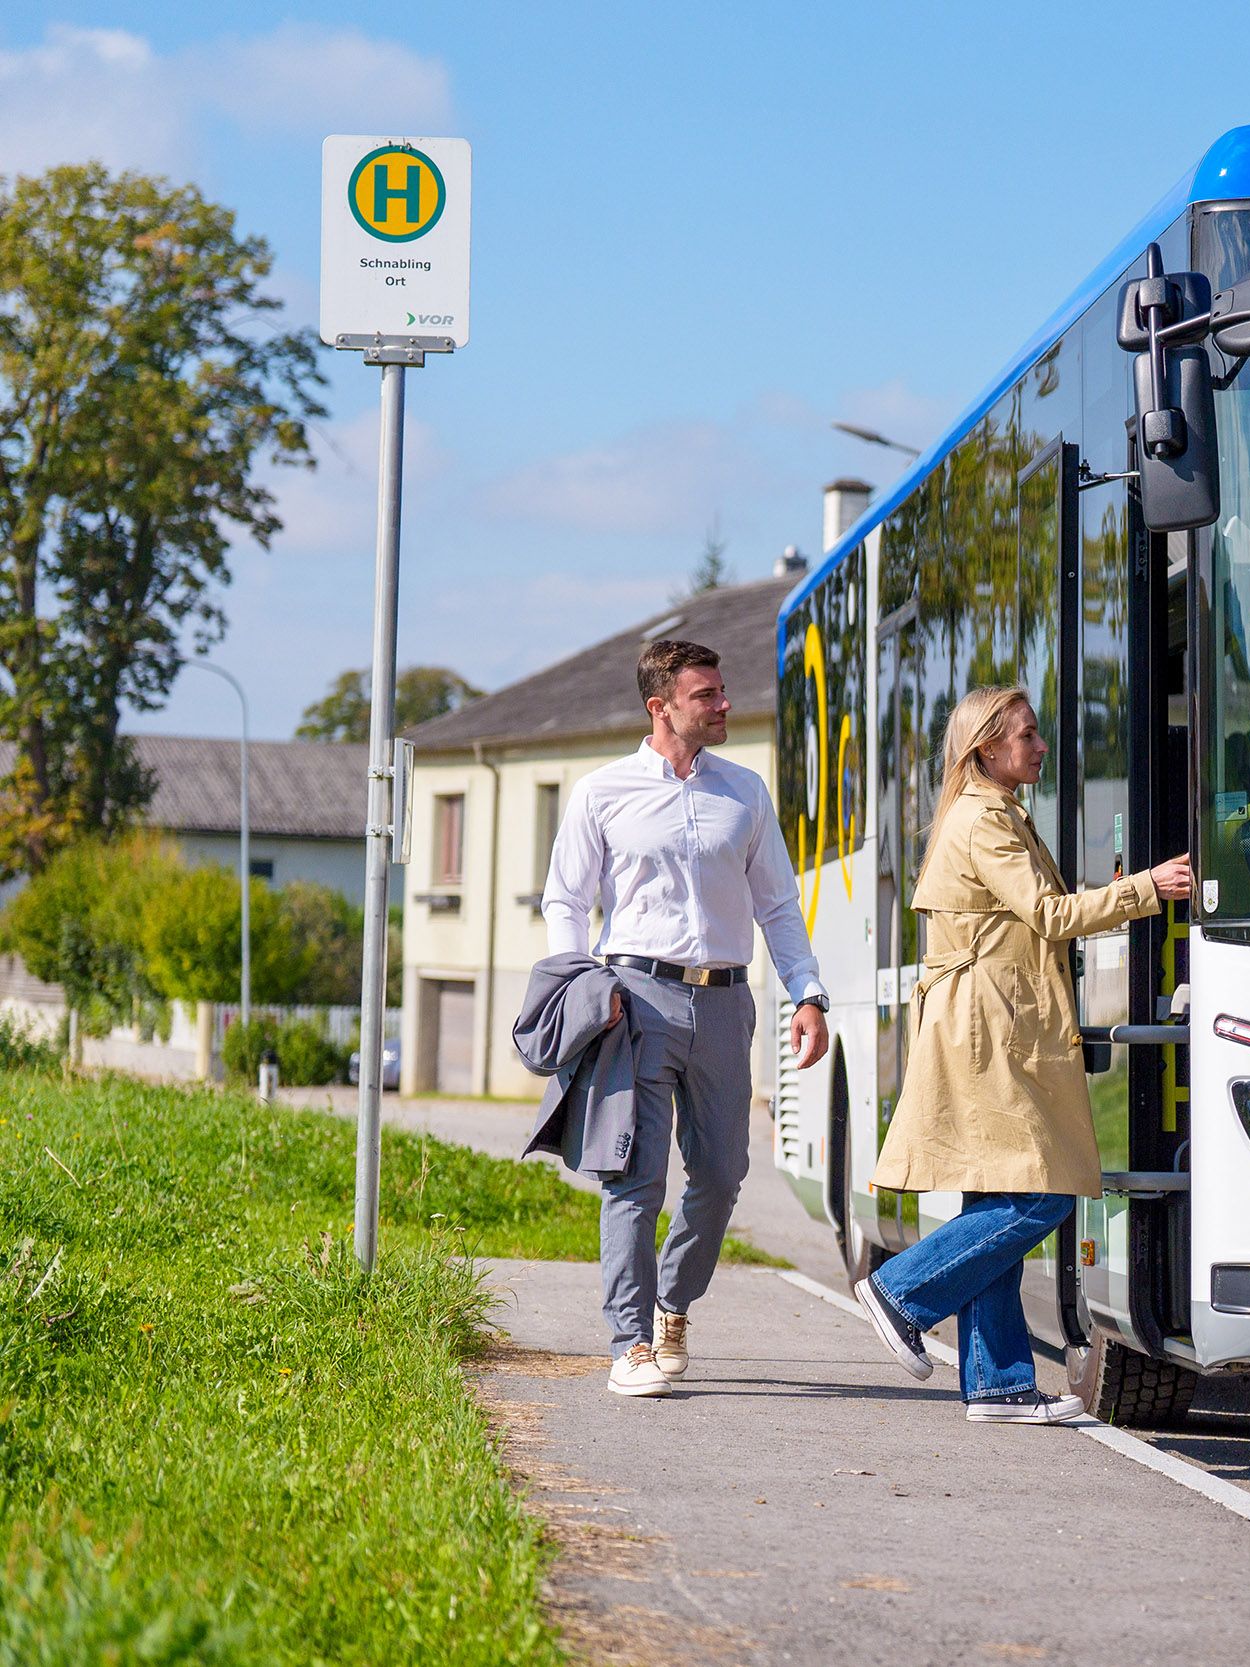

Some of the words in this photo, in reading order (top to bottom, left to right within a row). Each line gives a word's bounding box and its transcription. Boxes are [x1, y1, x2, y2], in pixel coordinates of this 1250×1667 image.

[373, 164, 420, 223] H
[360, 258, 431, 271] Schnabling
[385, 276, 406, 286] Ort
[419, 314, 455, 325] VOR
